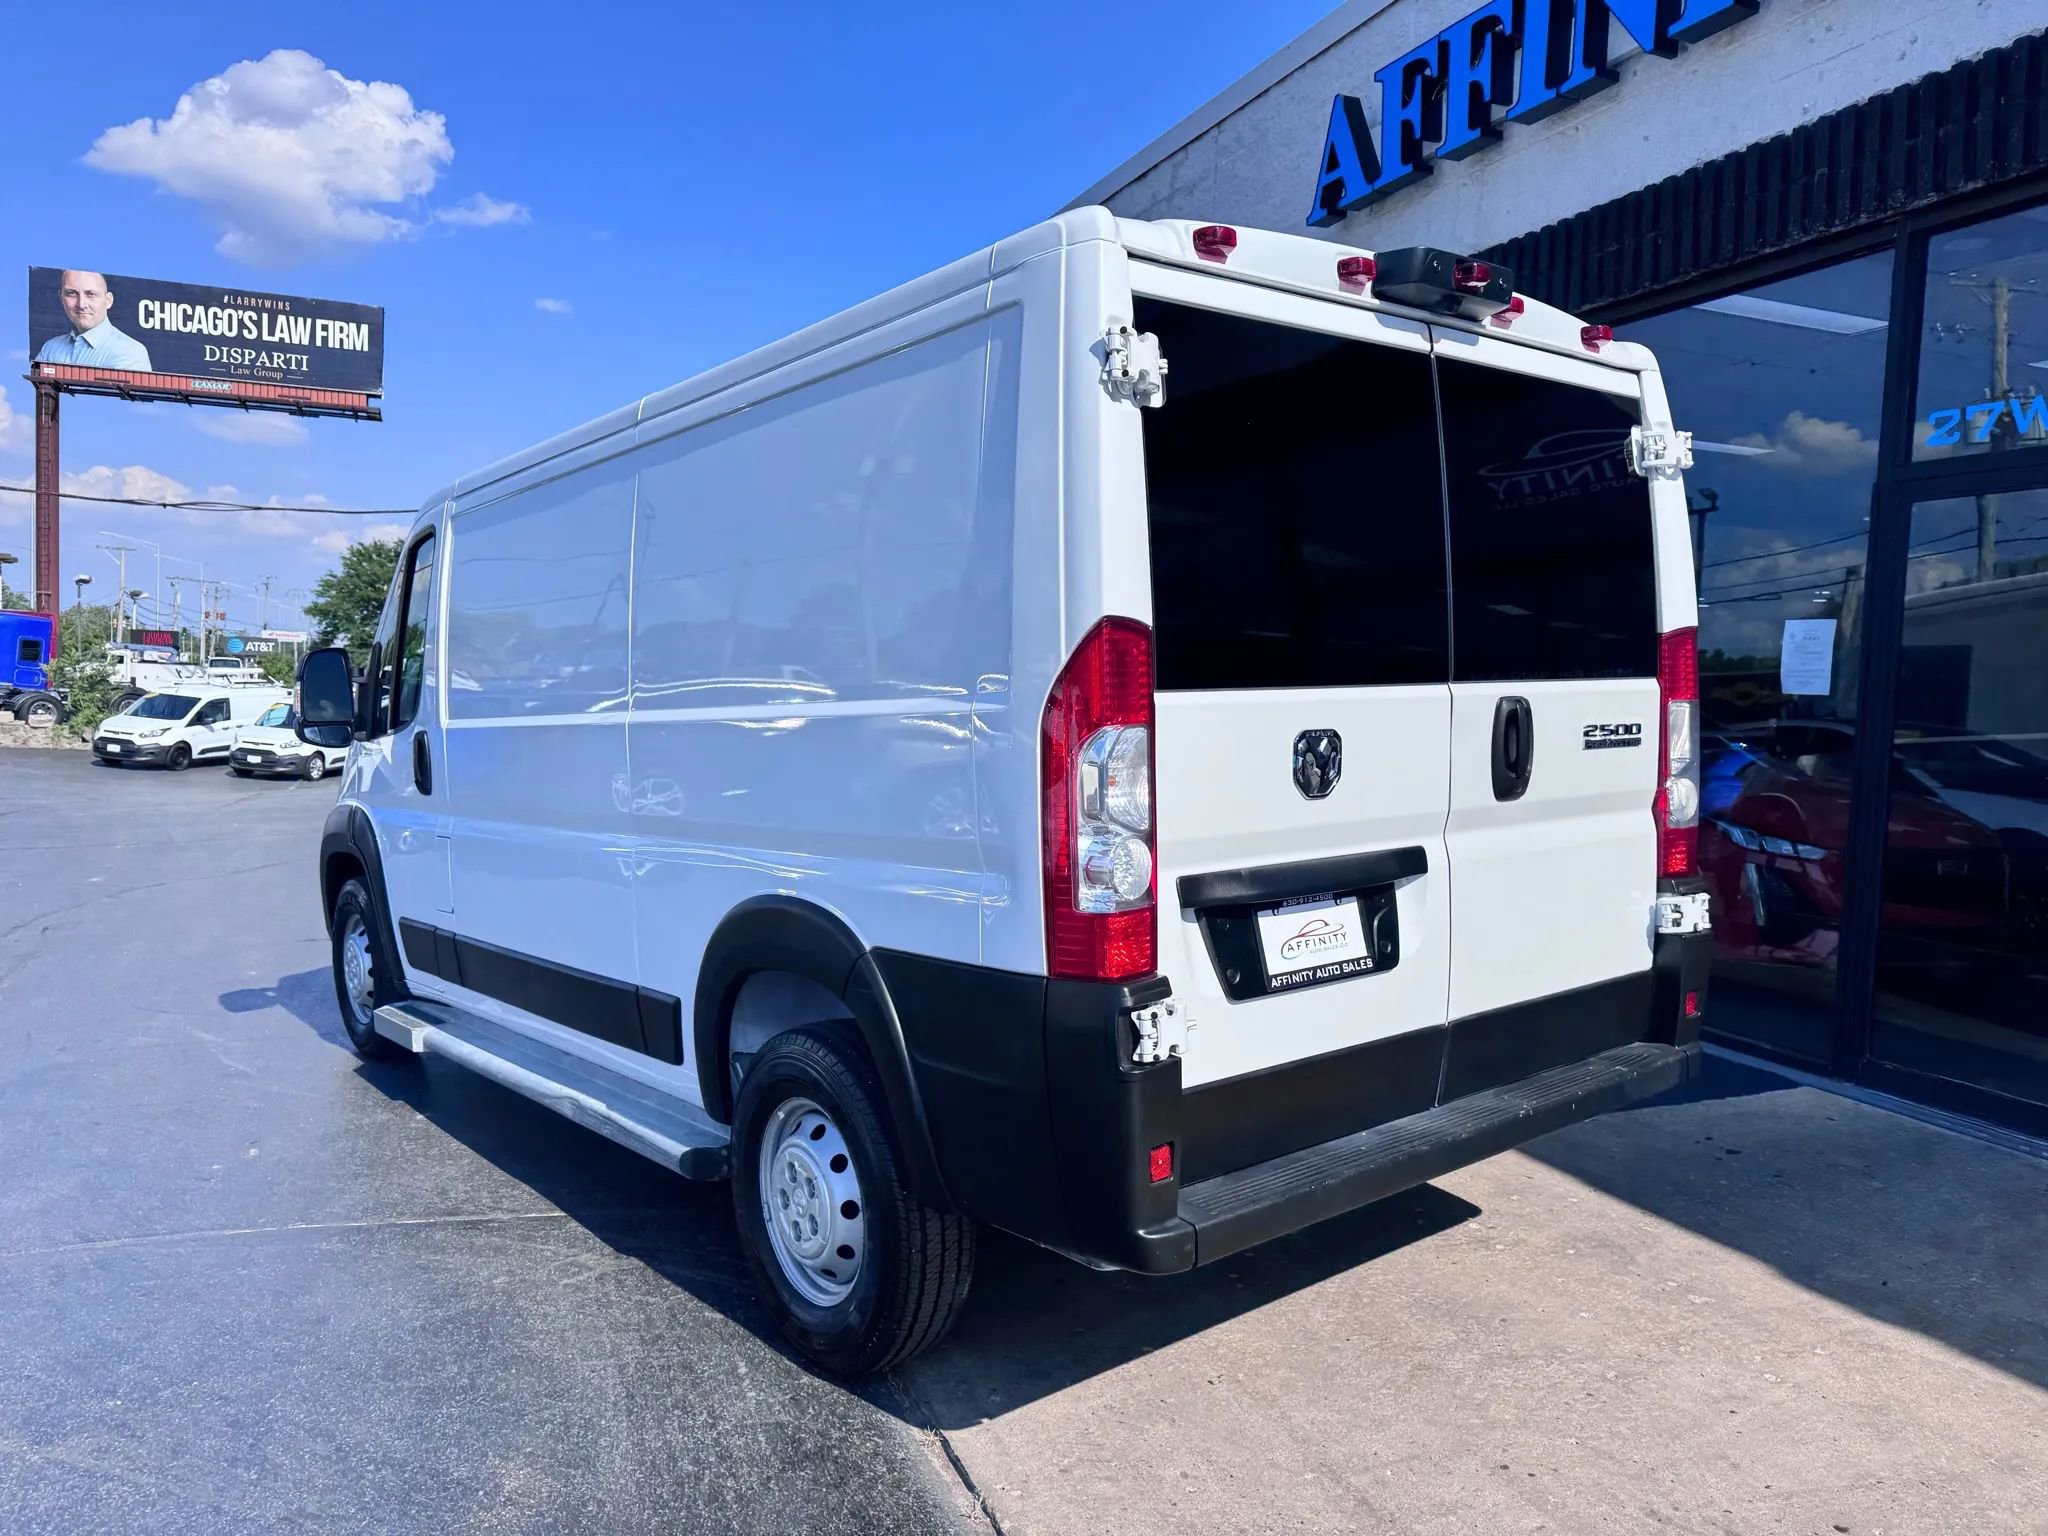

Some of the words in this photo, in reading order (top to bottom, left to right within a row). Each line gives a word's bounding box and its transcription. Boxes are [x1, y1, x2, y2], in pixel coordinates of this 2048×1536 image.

[223, 295, 290, 311] #LARRYWINS
[138, 299, 258, 340] CHICAGO'S
[262, 312, 312, 346] LAW
[315, 318, 369, 352] FIRM
[204, 344, 309, 371] DISPARTI
[231, 365, 251, 375] Law
[254, 368, 284, 380] Group
[193, 380, 230, 391] LAMAR
[245, 641, 275, 652] AT&T
[1583, 723, 1642, 737] 2500
[1287, 932, 1347, 952] AFFINITY
[1271, 969, 1314, 988] AFFINITY
[1316, 965, 1341, 979] AUTO
[1342, 958, 1374, 973] SALES
